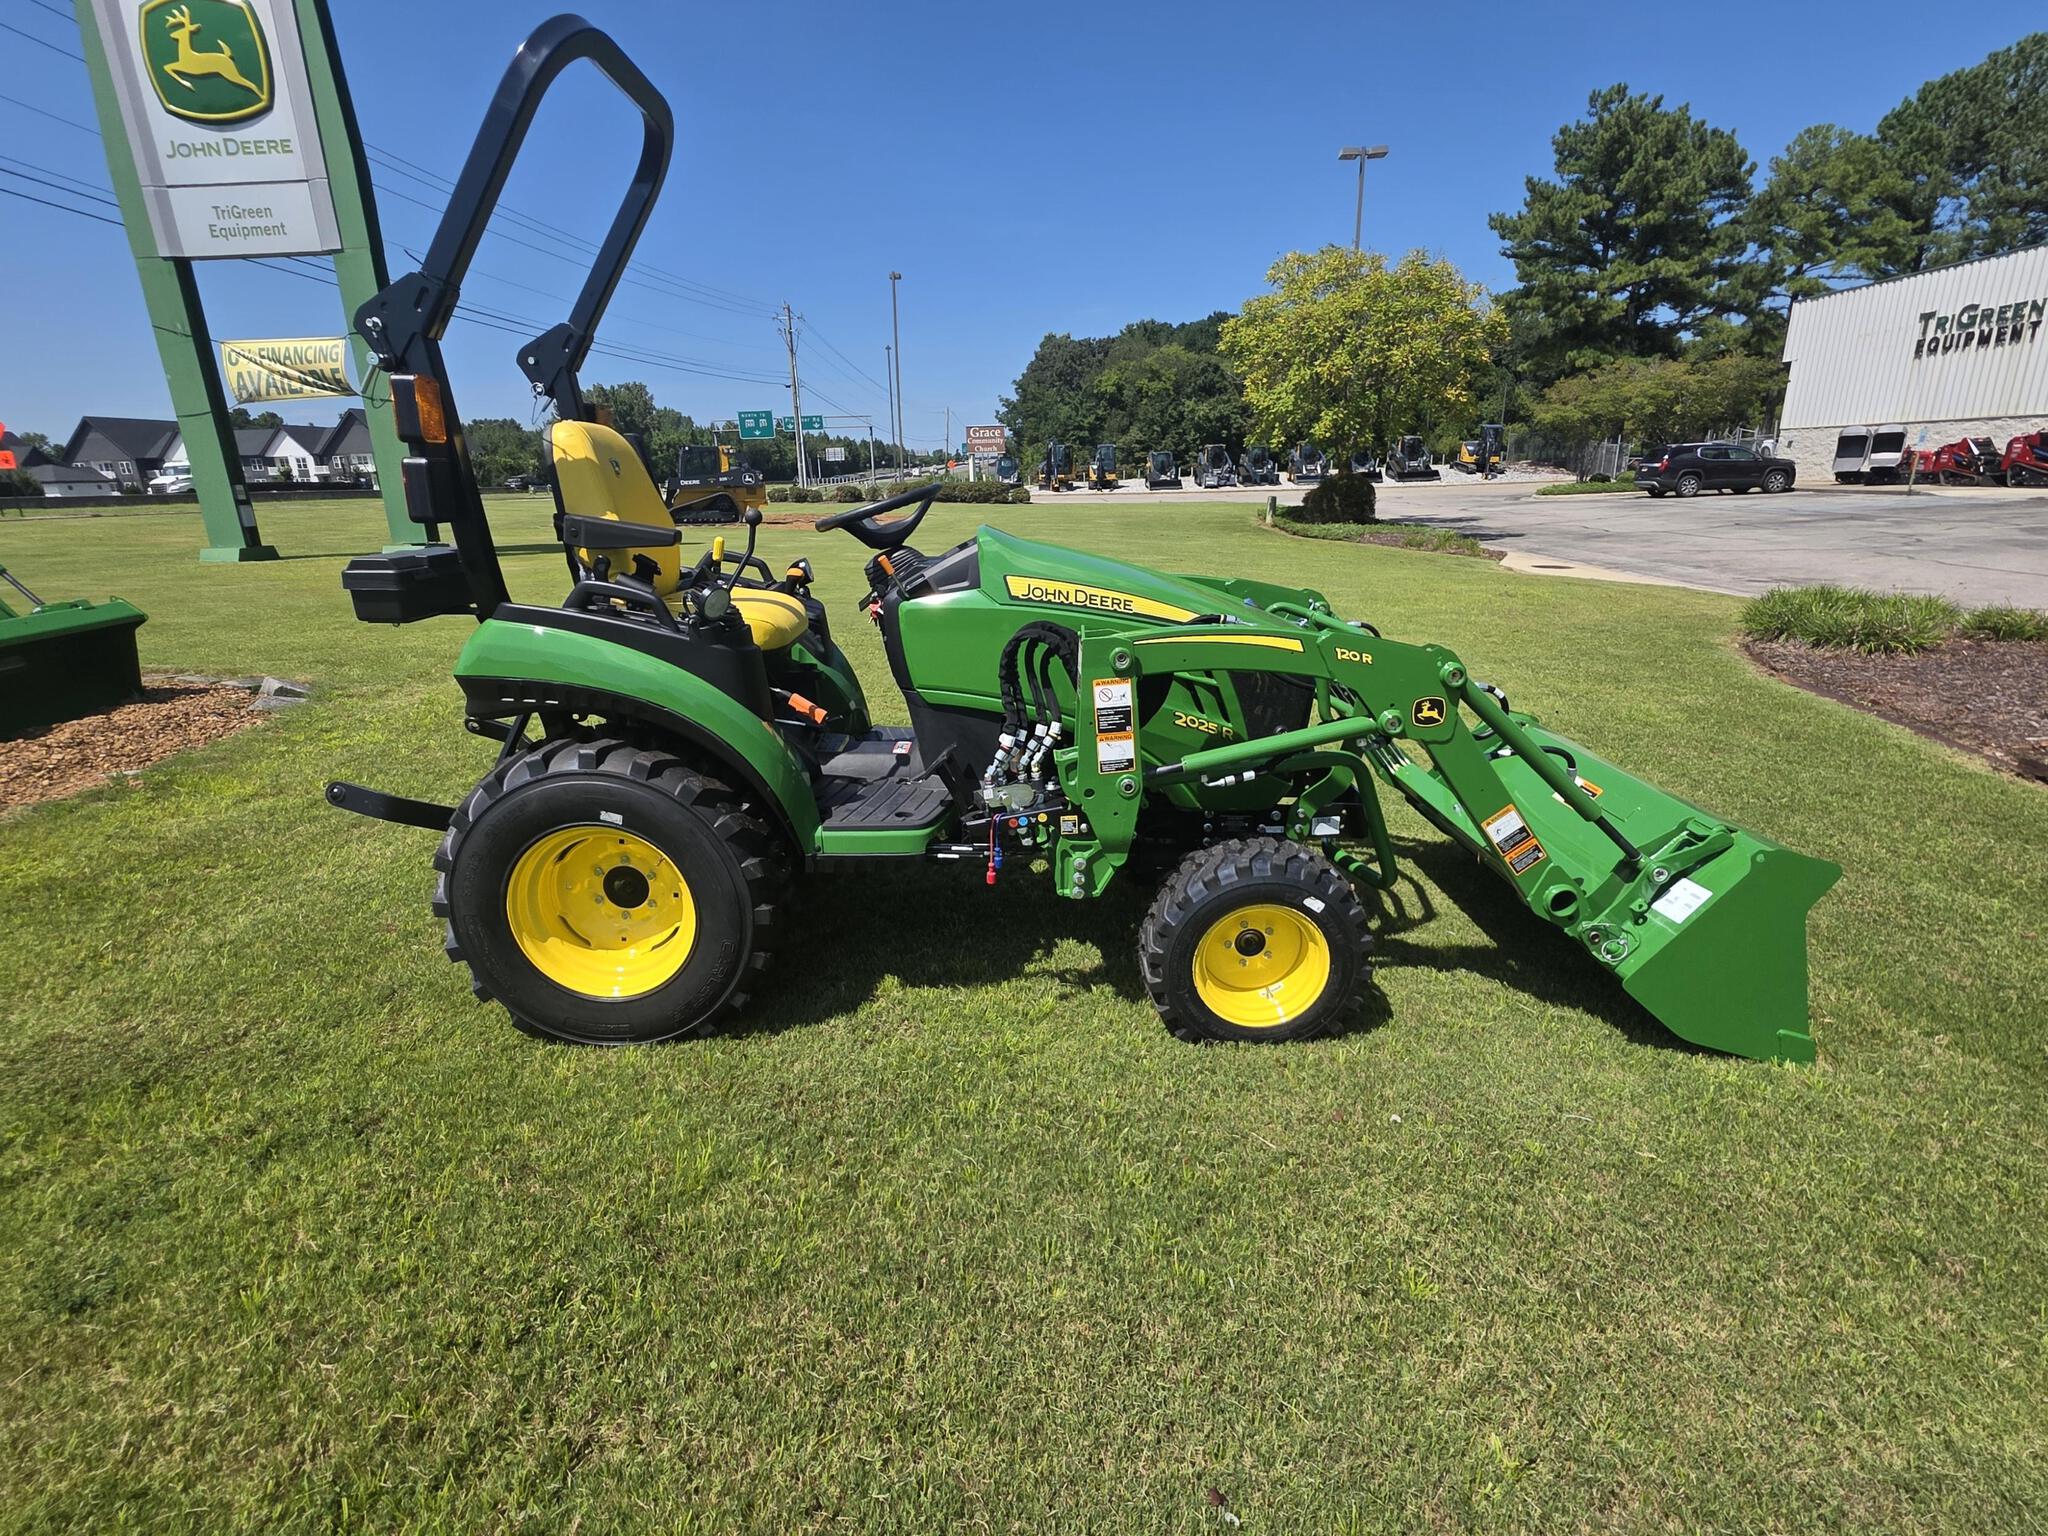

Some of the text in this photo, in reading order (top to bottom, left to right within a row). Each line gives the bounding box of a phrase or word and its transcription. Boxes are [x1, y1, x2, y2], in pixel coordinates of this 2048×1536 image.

[166, 138, 294, 159] JOHN DEERE
[211, 205, 273, 220] TriGreen
[208, 221, 288, 241] Equipment
[1914, 320, 2042, 360] EQUIPMENT
[257, 344, 339, 366] FINANCING
[968, 437, 1003, 445] Community
[970, 427, 1001, 437] Grace
[1021, 583, 1134, 611] JOHN DEERE
[1335, 647, 1373, 664] 120 R
[1173, 711, 1234, 740] 2025 R
